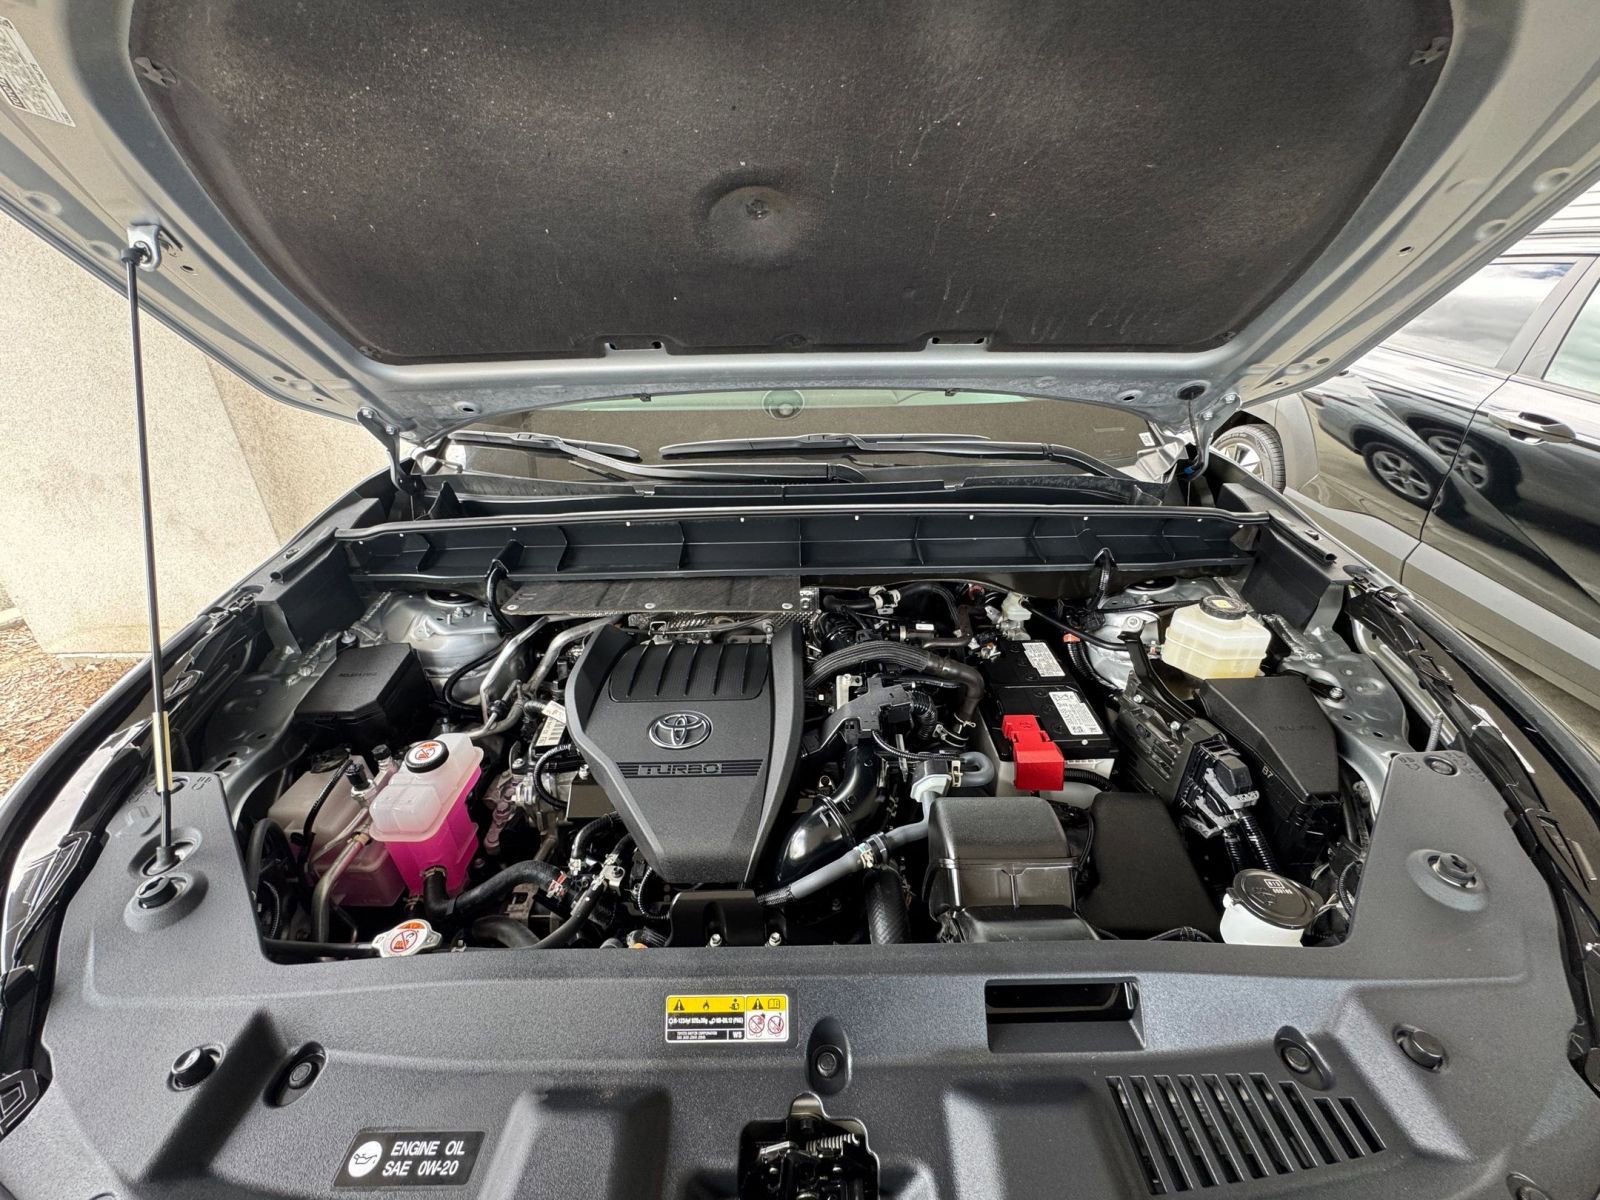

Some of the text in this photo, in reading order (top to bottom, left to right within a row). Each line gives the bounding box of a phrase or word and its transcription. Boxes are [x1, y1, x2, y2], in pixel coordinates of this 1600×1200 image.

[641, 763, 719, 775] TURBO
[390, 1140, 466, 1156] ENGINE OIL
[382, 1160, 459, 1176] SAE 0W-20
